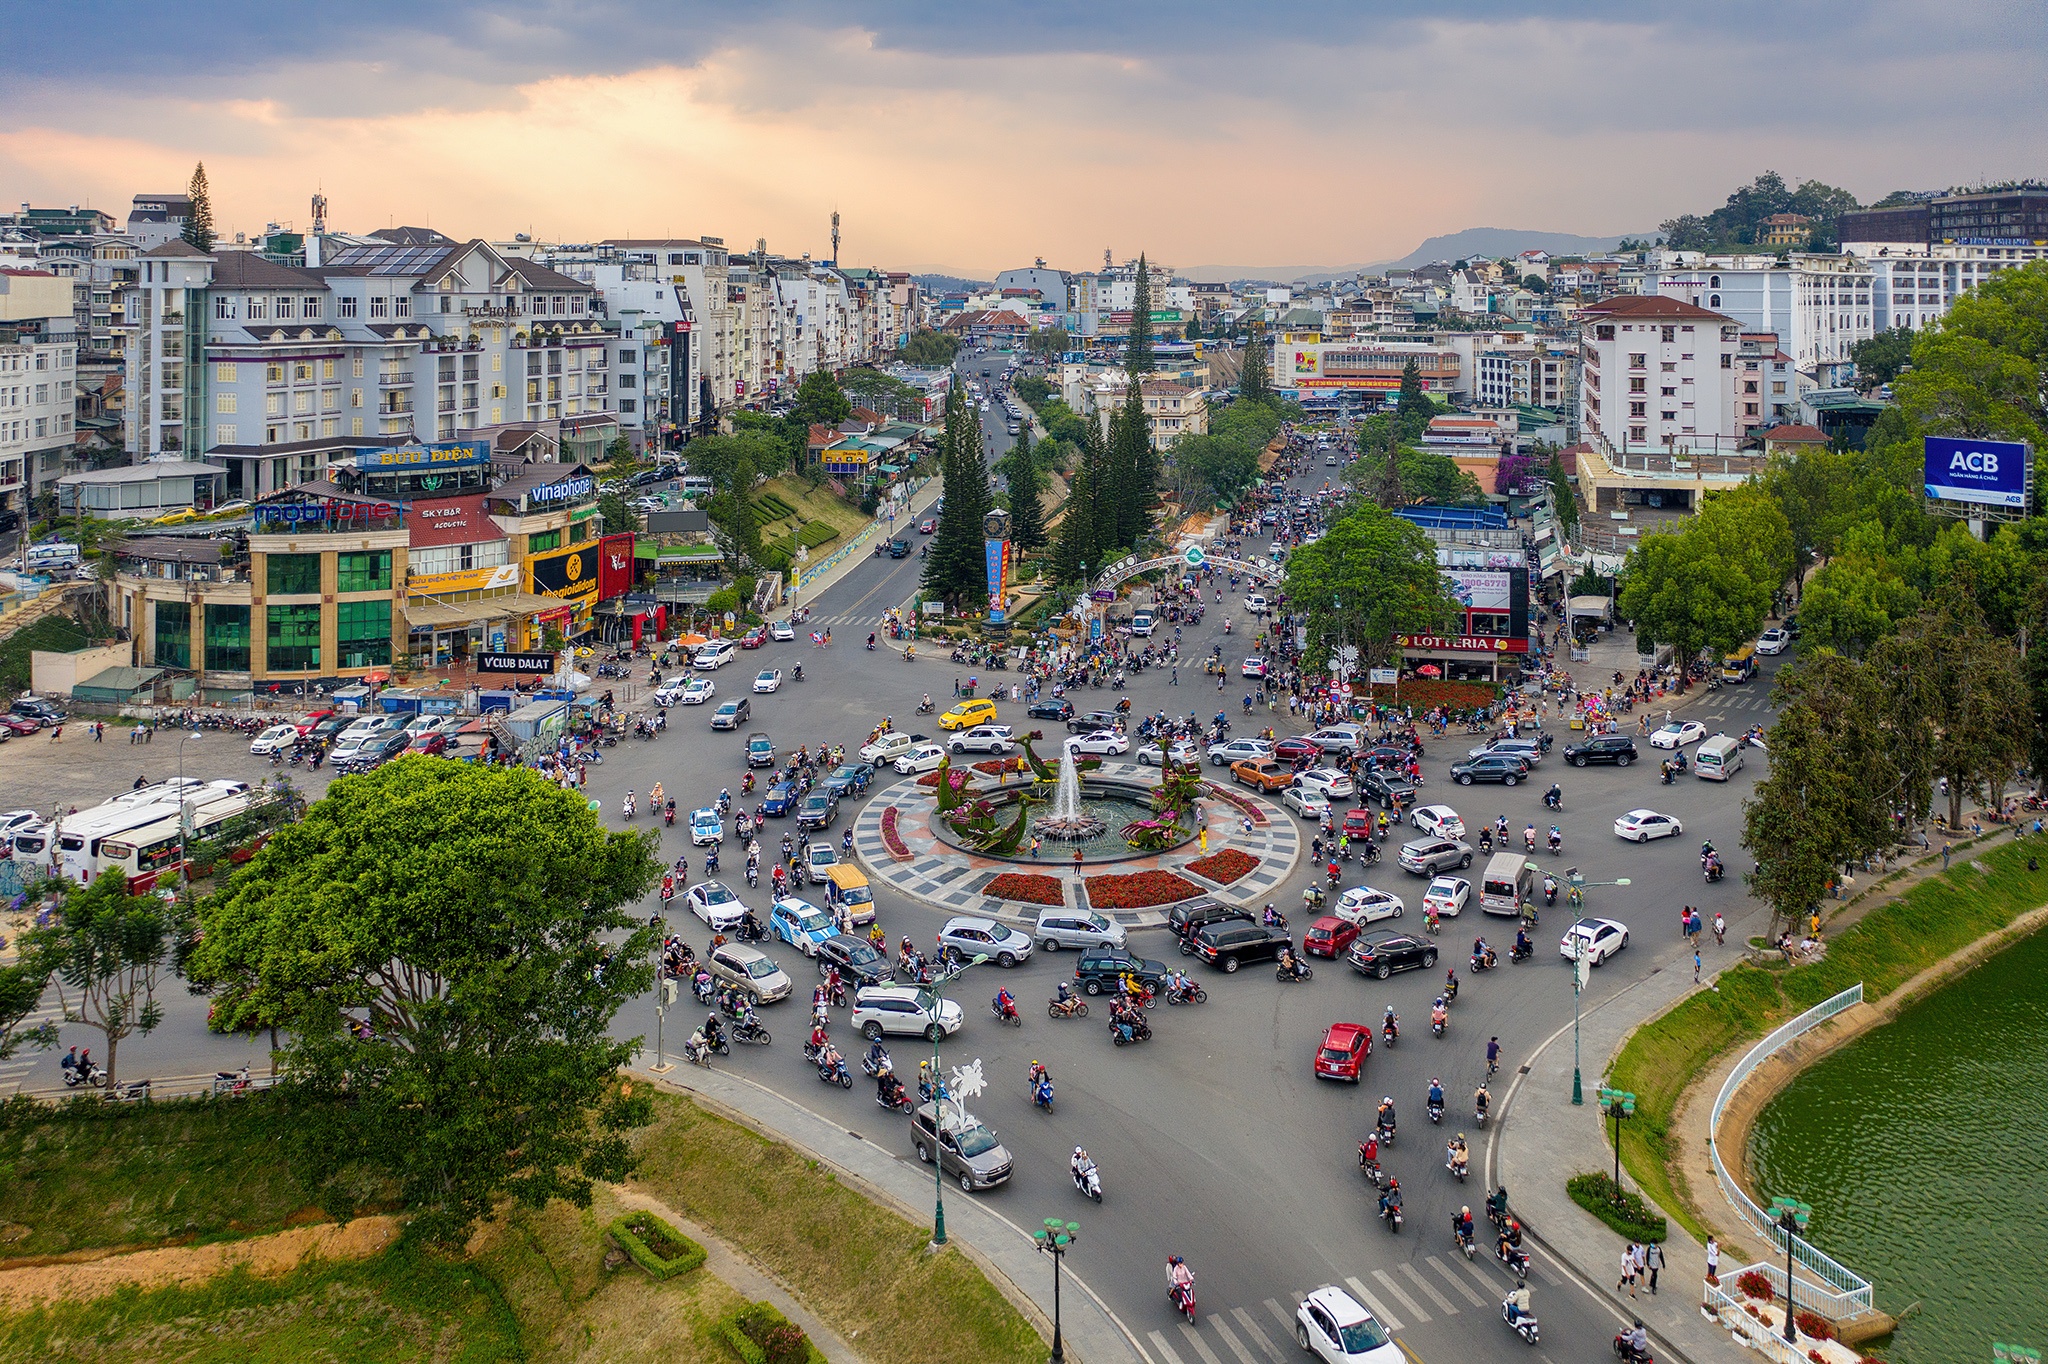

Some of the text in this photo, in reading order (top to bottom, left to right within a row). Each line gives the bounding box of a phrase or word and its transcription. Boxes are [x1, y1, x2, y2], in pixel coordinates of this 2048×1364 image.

[466, 306, 522, 317] TTC HOTEL
[380, 446, 474, 465] BƯU ĐIỆN
[1949, 451, 1999, 473] ACB
[531, 477, 591, 501] vinaphone
[2005, 495, 2021, 503] ACB
[254, 498, 392, 522] mobifone
[434, 519, 467, 530] ACOUSTIC
[541, 577, 597, 599] thegioididong
[1461, 579, 1507, 587] 1900-6778
[1413, 637, 1488, 649] LOTTERIA
[518, 657, 550, 670] DALAT
